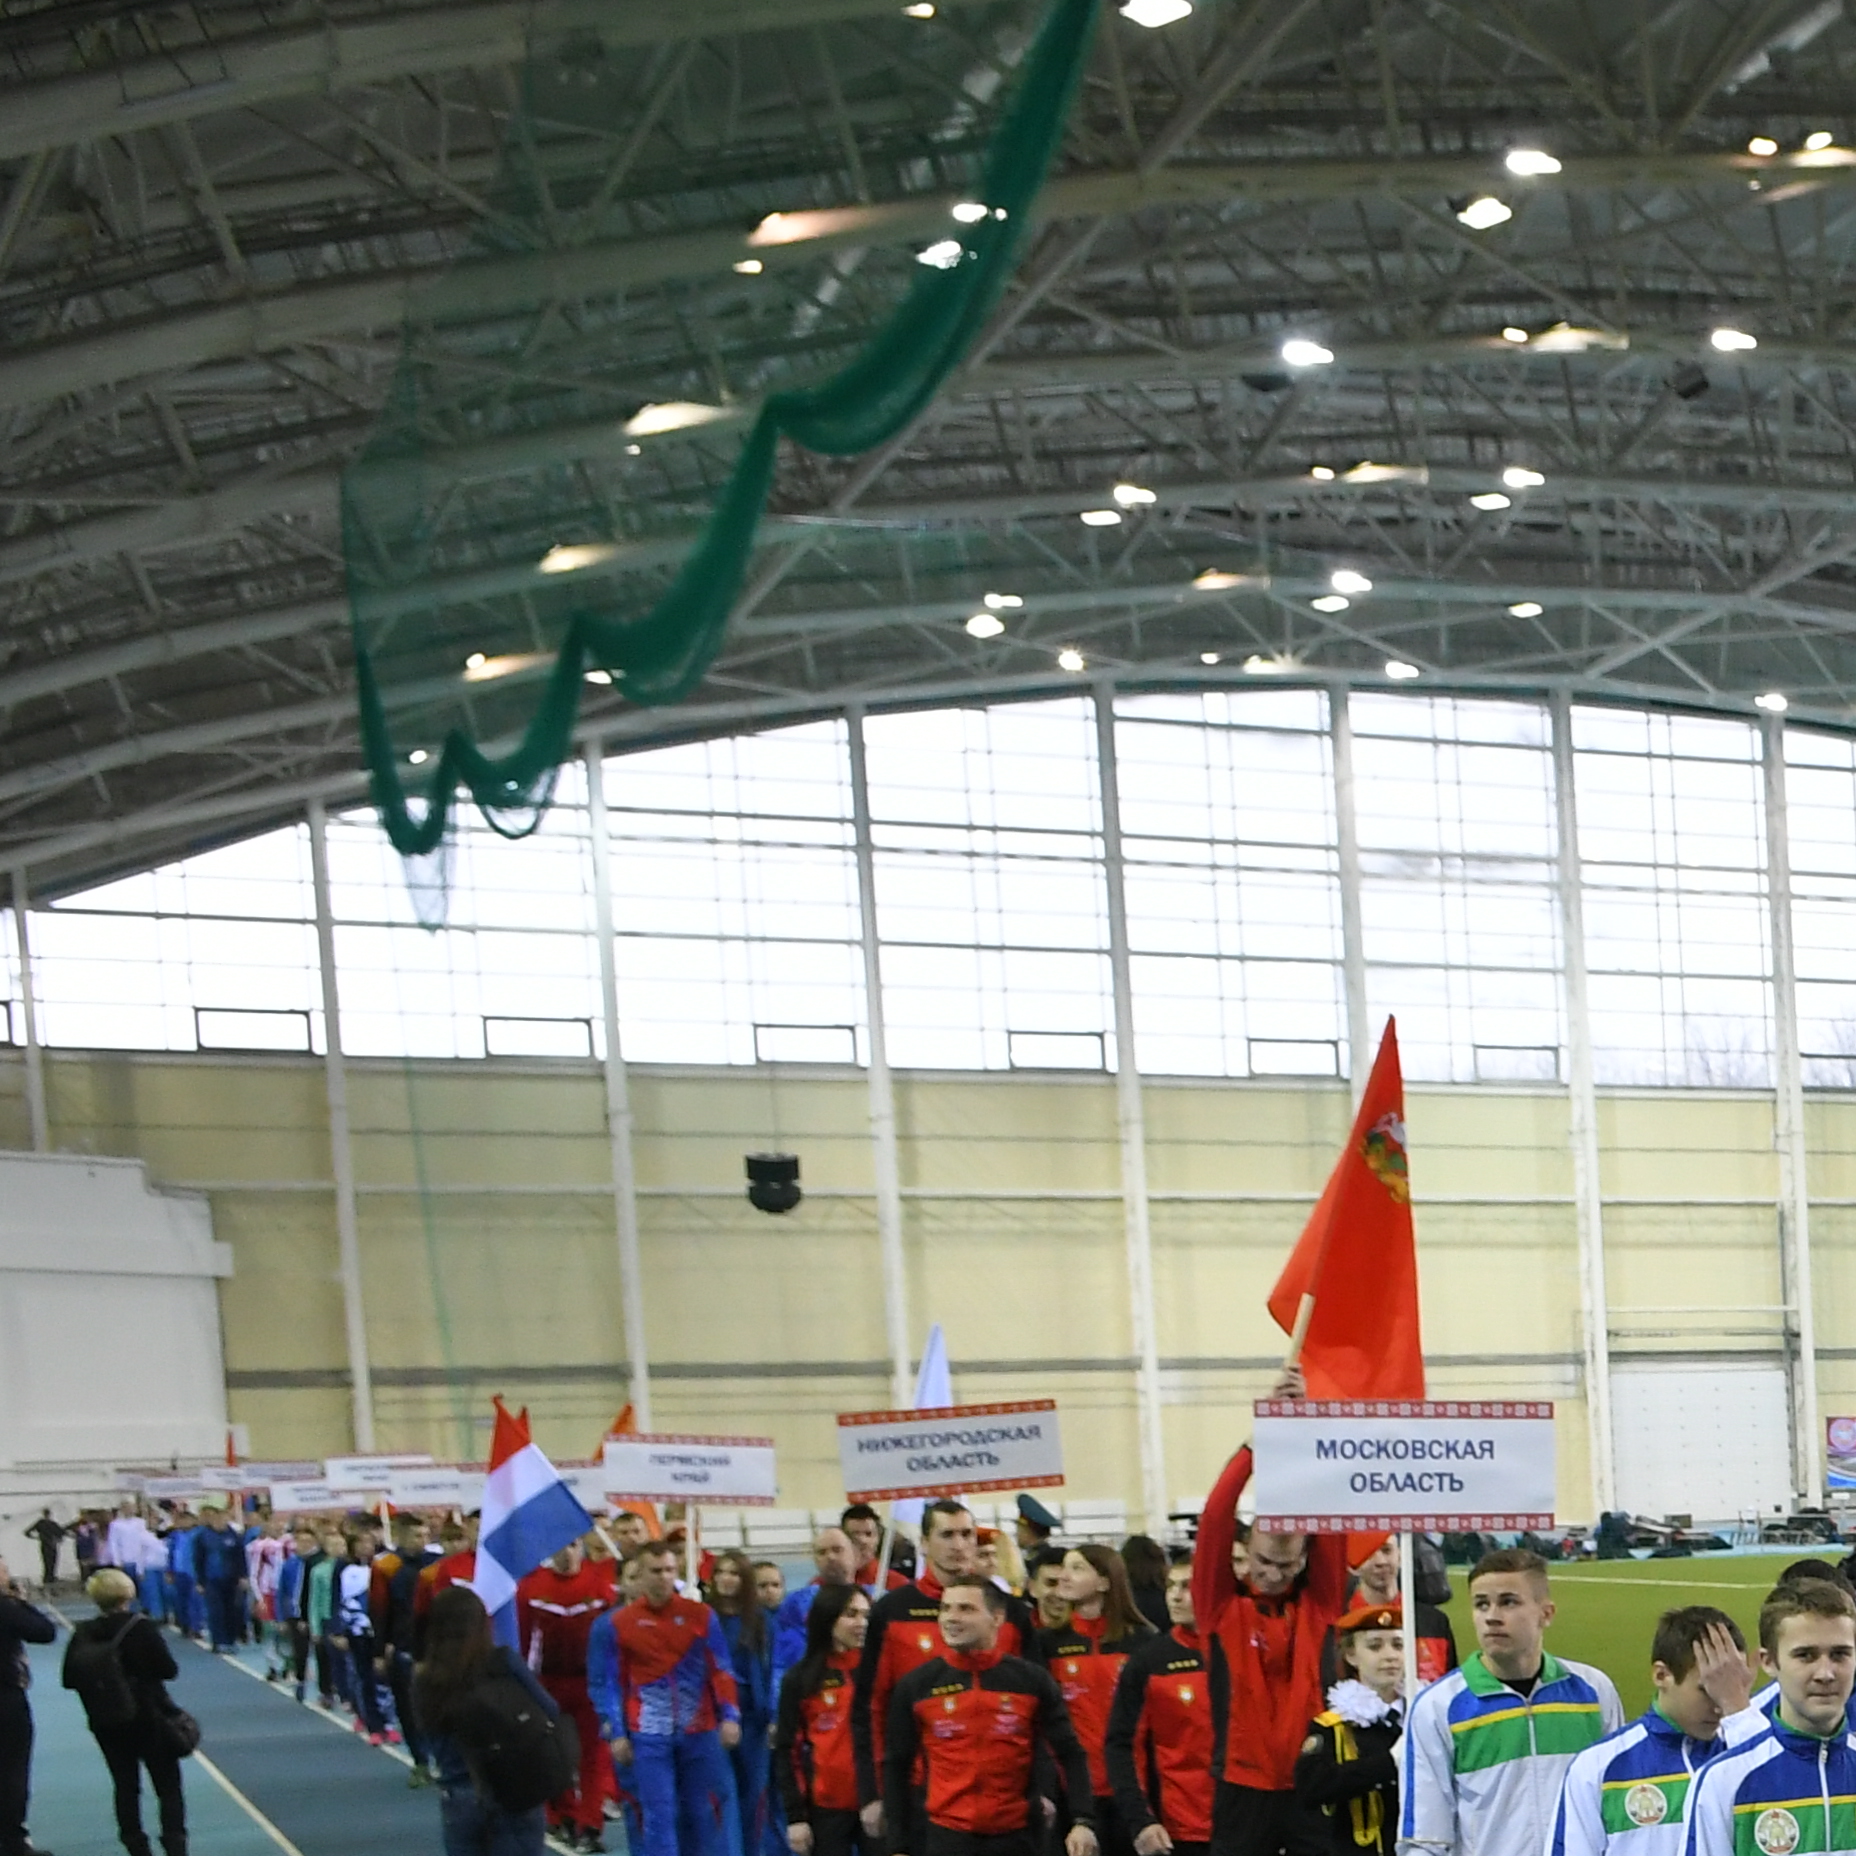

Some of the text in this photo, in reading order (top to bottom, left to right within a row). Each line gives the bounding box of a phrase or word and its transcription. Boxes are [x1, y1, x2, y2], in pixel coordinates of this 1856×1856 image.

[857, 1424, 1042, 1453] НИЖЕГОРОДСКАЯ
[1315, 1439, 1495, 1460] МОСКОВСКАЯ
[906, 1451, 1001, 1472] ОБЛАСТЬ
[1349, 1472, 1464, 1493] ОБЛАСТЬ
